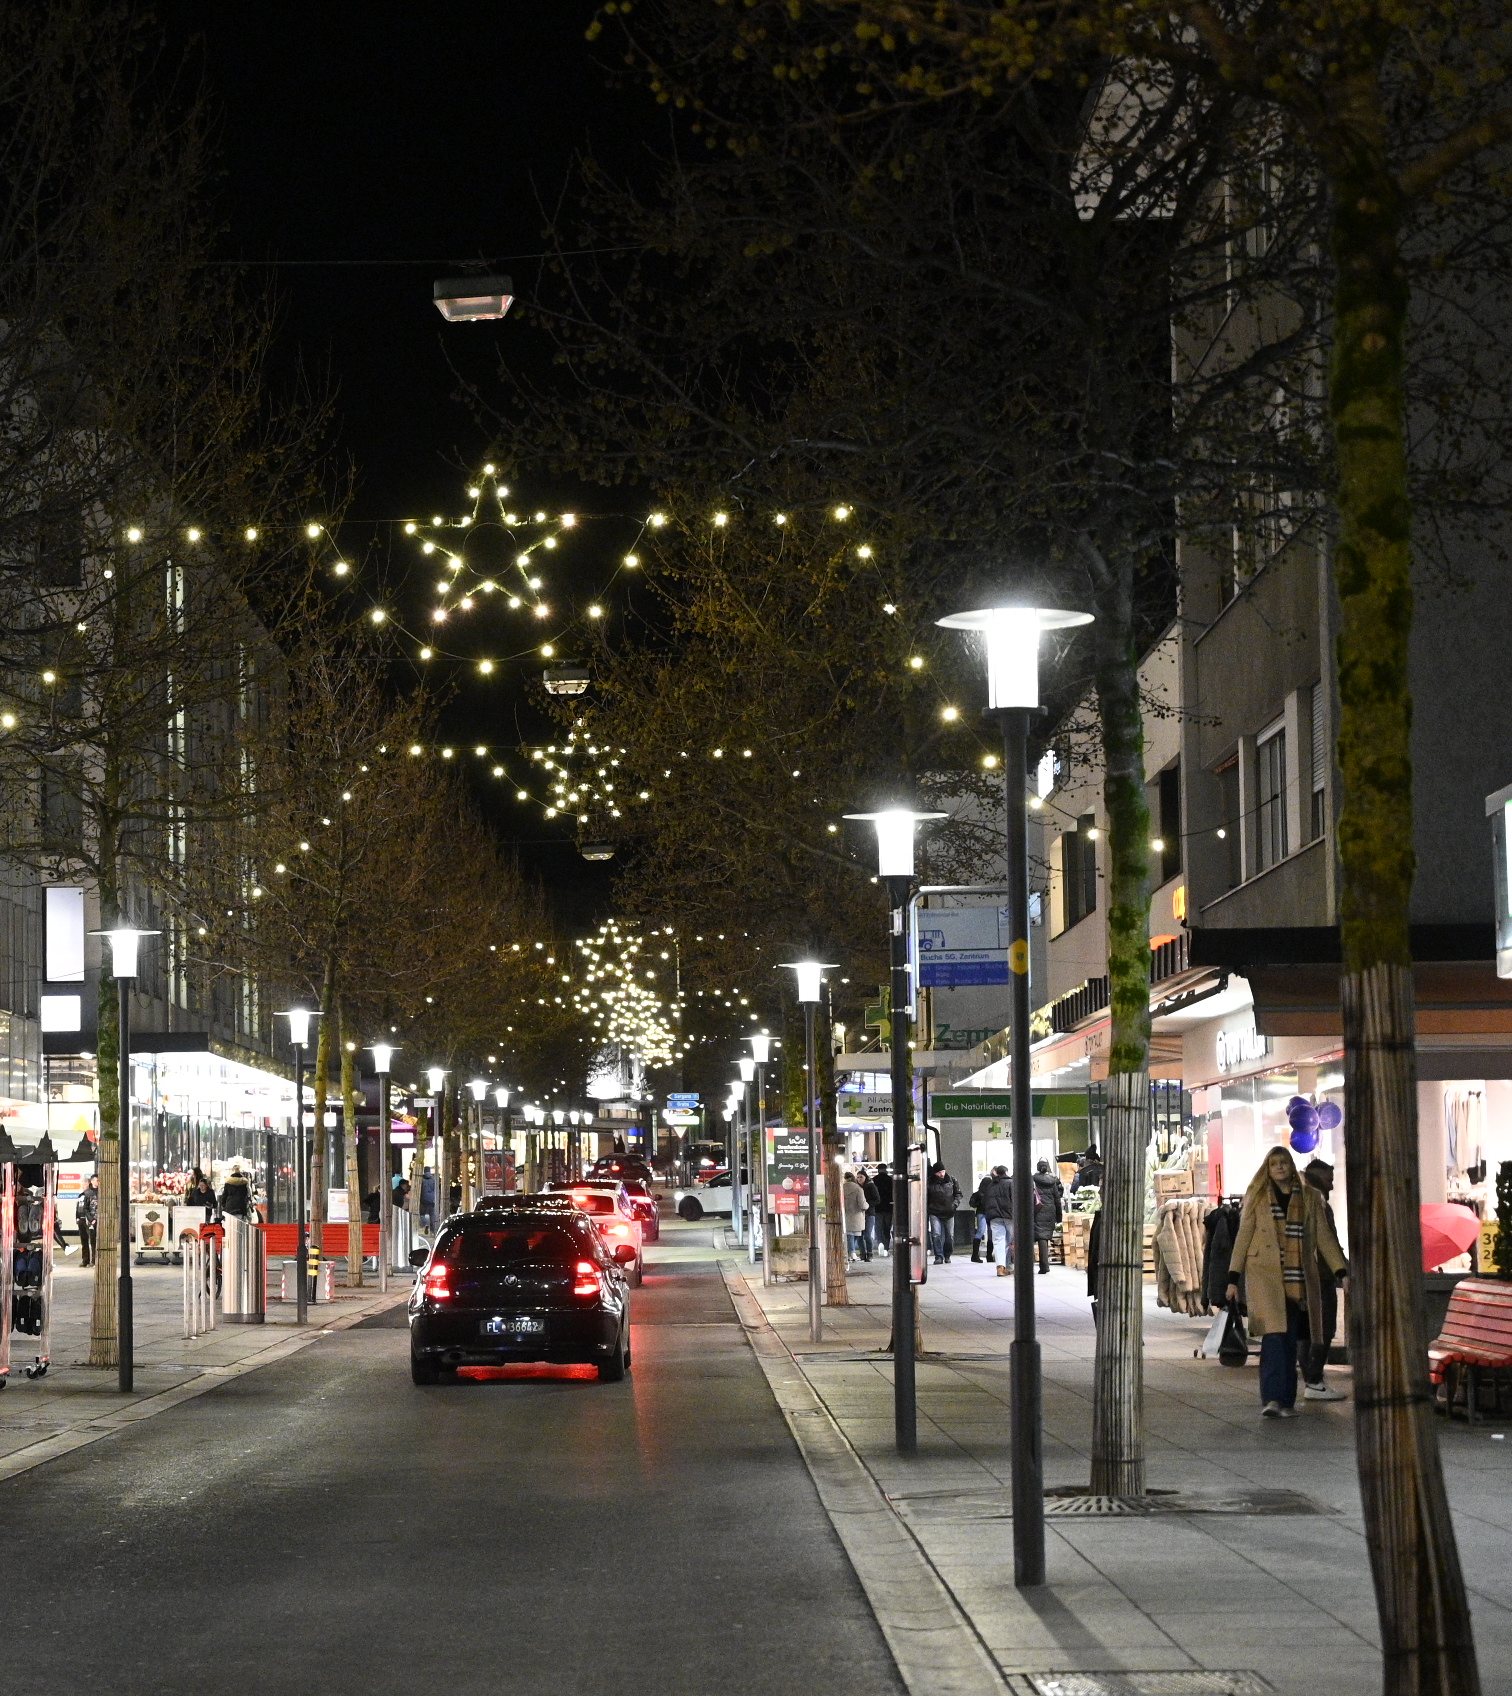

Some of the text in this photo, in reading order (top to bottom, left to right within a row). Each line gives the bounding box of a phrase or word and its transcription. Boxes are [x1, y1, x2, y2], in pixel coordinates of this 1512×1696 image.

[920, 953, 943, 961] Buchs
[944, 1102, 1010, 1111] Die Natürlichen.
[487, 1322, 499, 1332] FL
